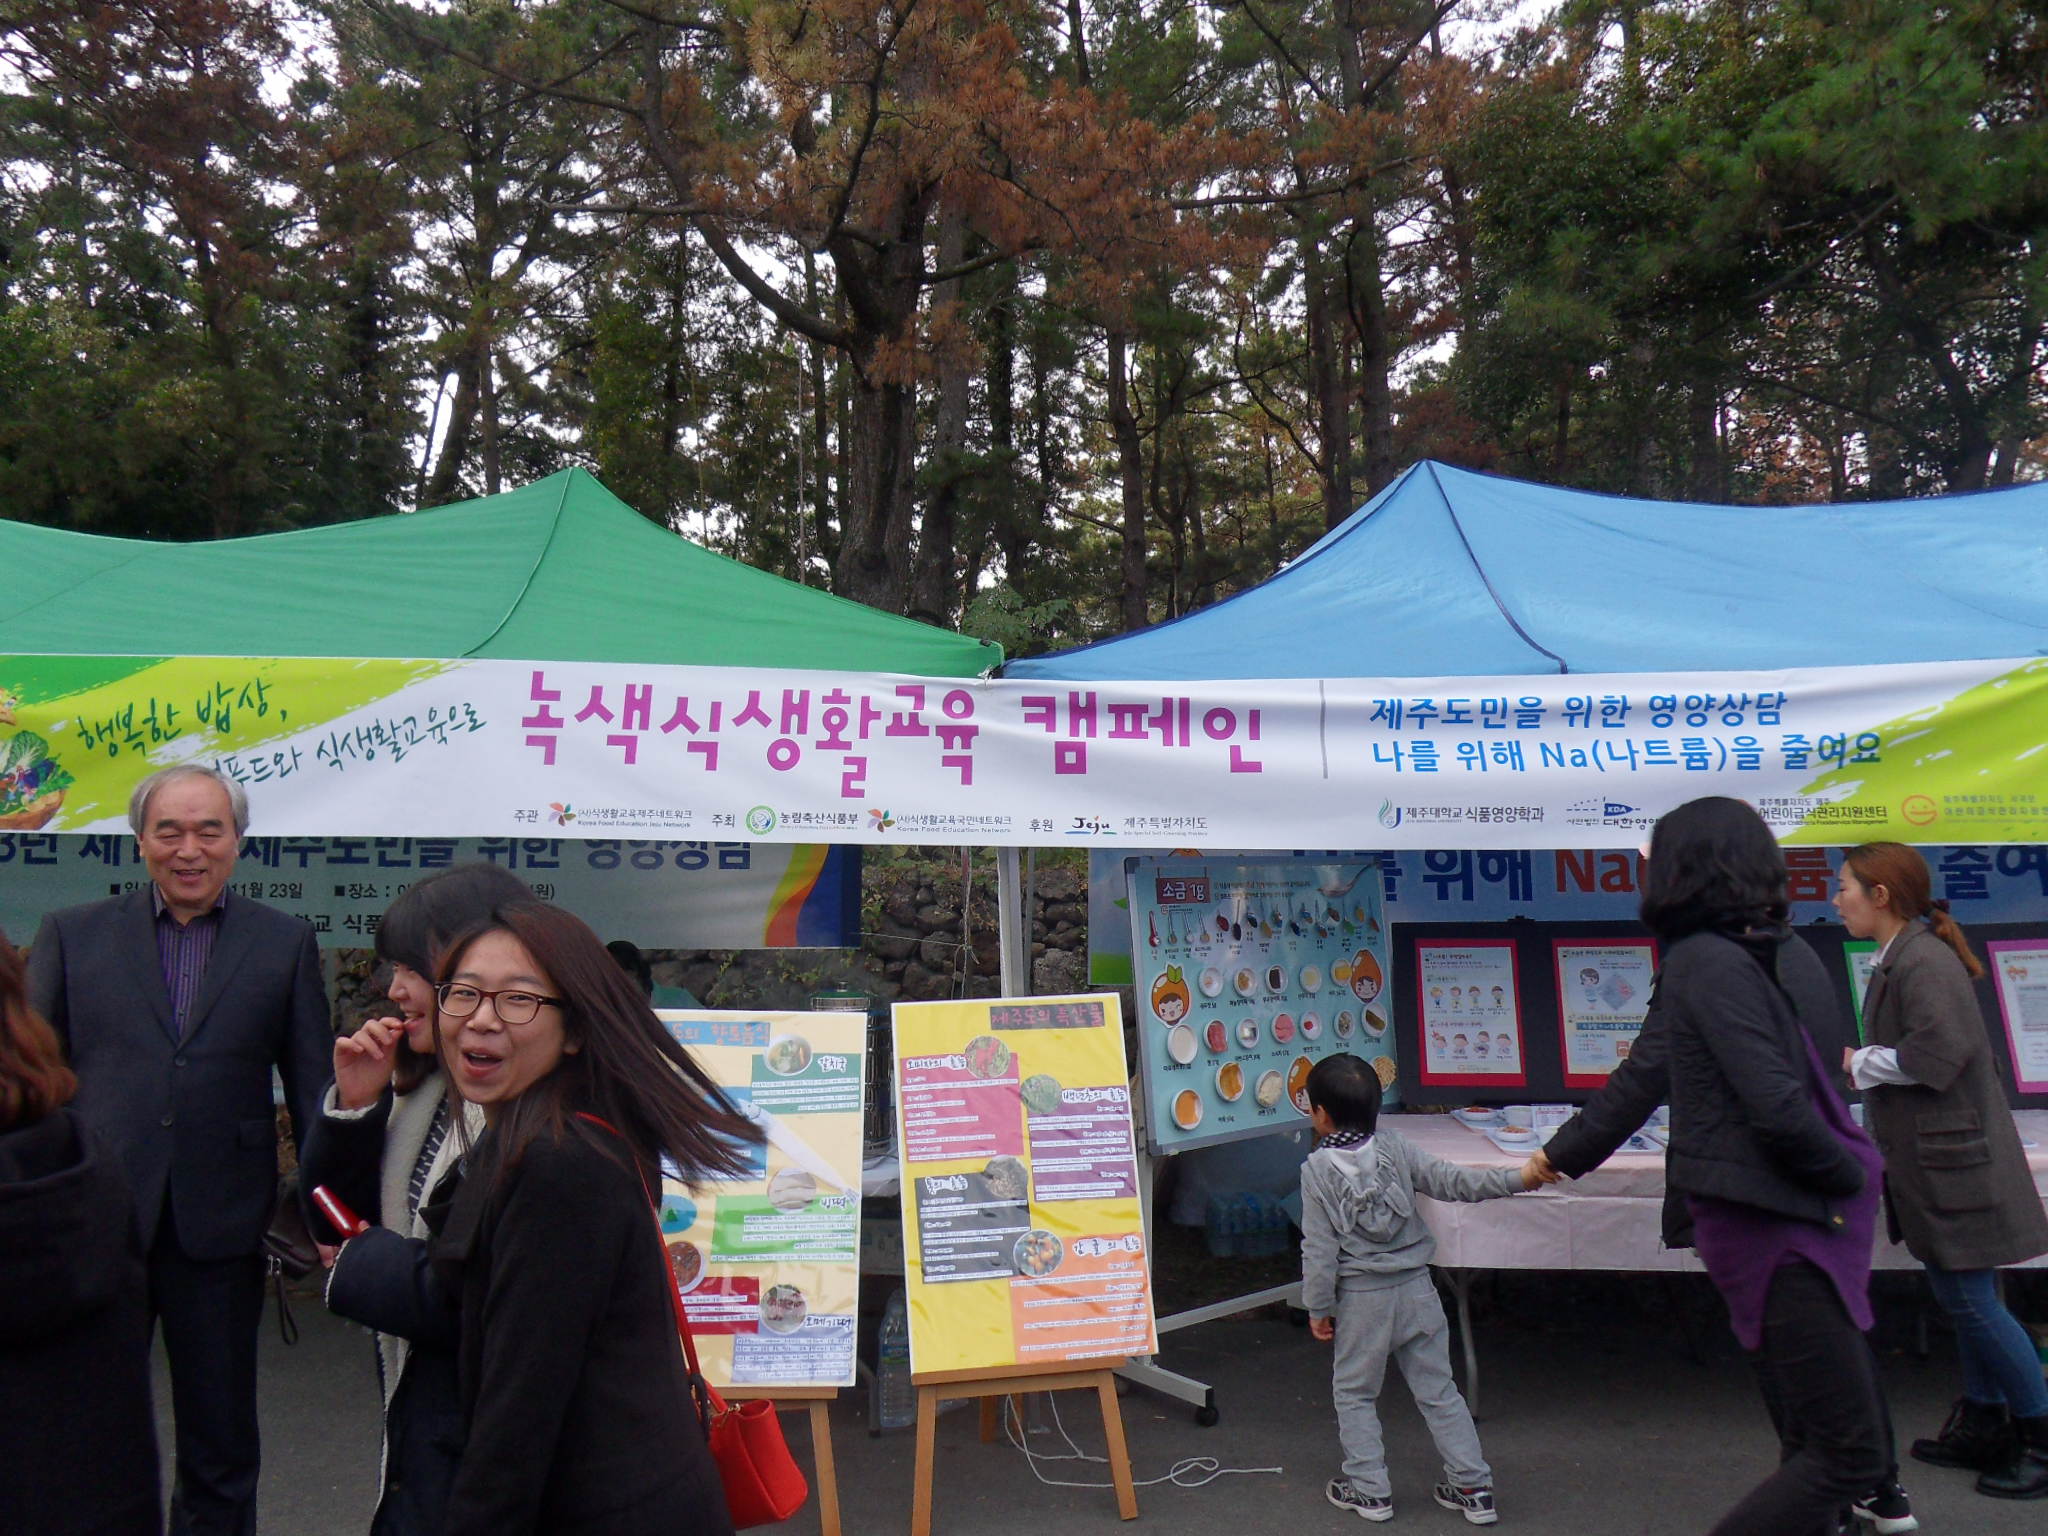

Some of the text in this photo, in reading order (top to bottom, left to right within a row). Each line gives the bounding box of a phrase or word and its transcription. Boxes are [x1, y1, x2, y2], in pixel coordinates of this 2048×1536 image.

[77, 677, 288, 757] 행복한 밥상,
[1369, 690, 1788, 730] 제주도민을 위한 영양상담
[521, 670, 1263, 798] 녹색식생활교육 캠페인
[215, 702, 487, 788] 푸드와 식생활교육으로
[1372, 731, 1882, 773] 나를 위해 Na(나트륨)을 줄여요
[513, 809, 539, 823] 주관
[711, 813, 736, 828] 주최
[779, 812, 859, 825] 농림축산식품부
[1123, 816, 1209, 830] 제주특별자치도
[1405, 806, 1545, 824] 제주대학교 식품영양학과
[1028, 818, 1054, 832] 후원
[1071, 815, 1110, 835] Jeju
[269, 882, 303, 899] 23일
[348, 883, 379, 899] 장소
[1162, 881, 1187, 899] 소금
[1192, 884, 1205, 900] 1g
[992, 1004, 1104, 1027] 제주도의 특산물
